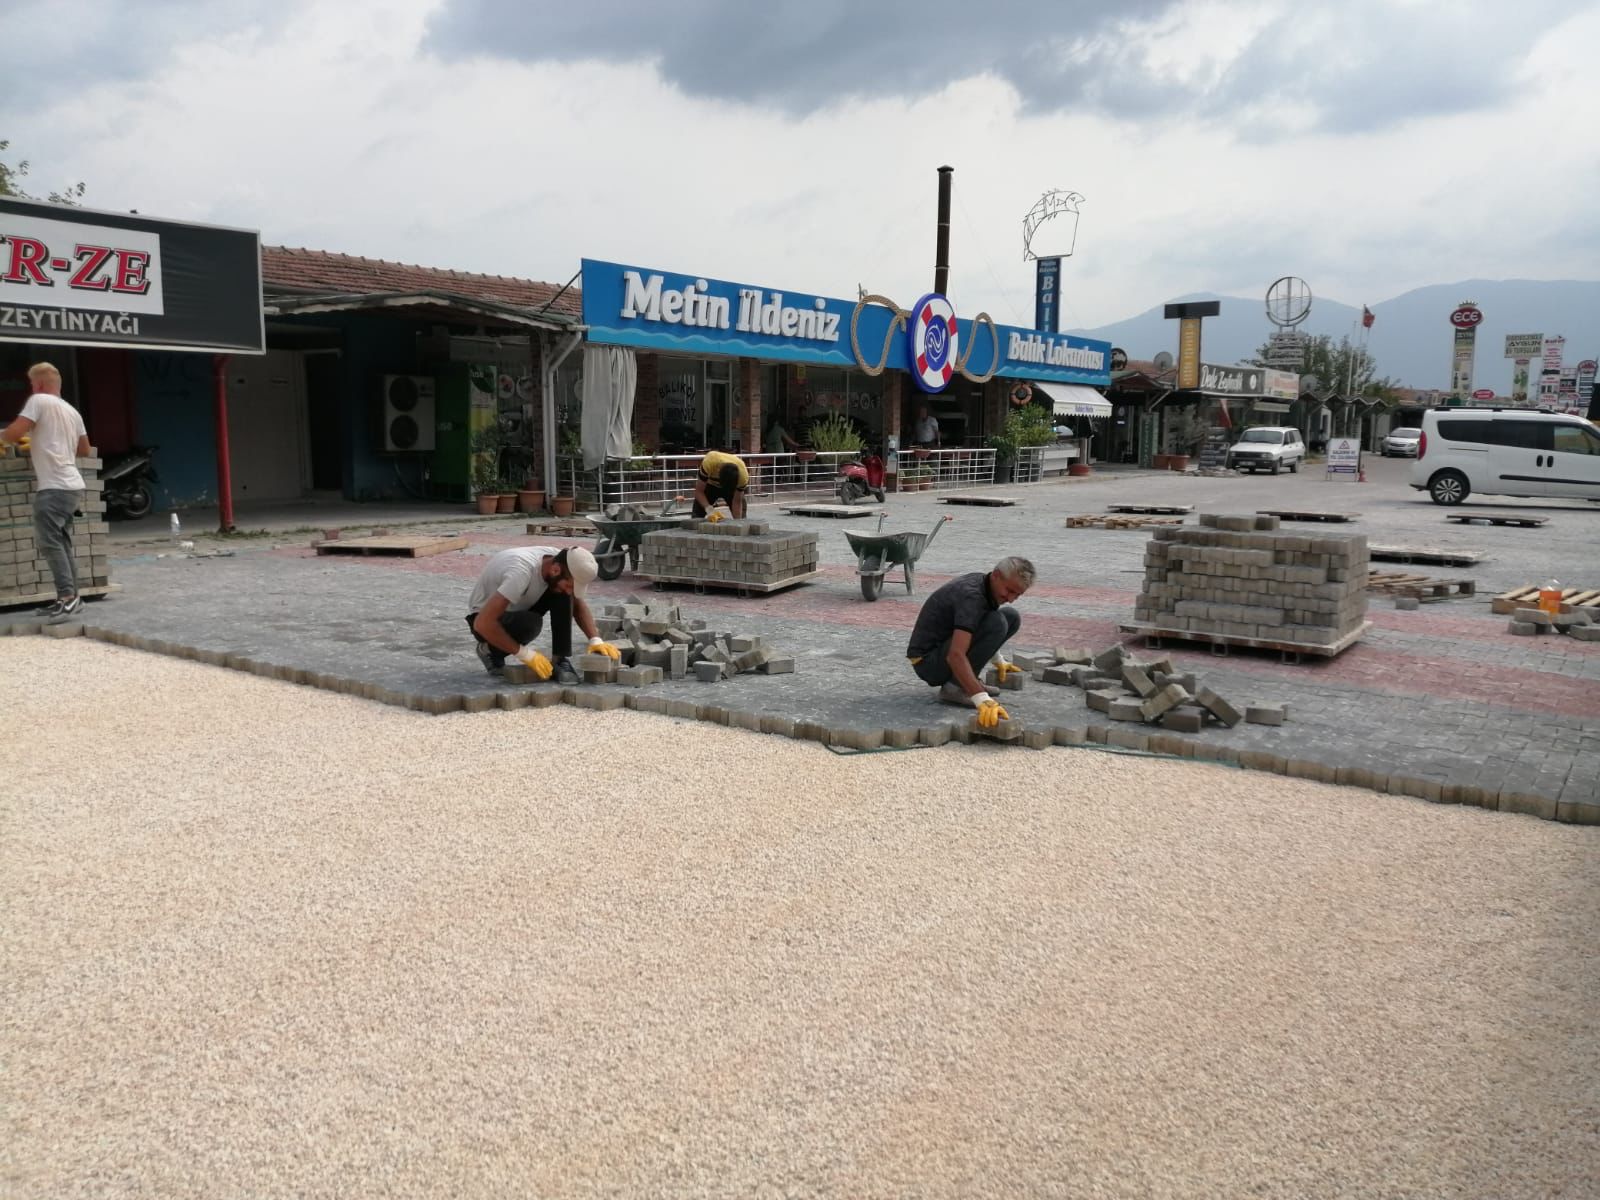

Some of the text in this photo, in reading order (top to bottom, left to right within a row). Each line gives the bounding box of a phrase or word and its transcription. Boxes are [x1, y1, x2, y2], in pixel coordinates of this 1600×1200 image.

[0, 234, 151, 295] R-ZE
[0, 307, 139, 336] ZEYTİNYAĞI
[620, 270, 730, 329] Metin
[1453, 311, 1479, 323] ECE
